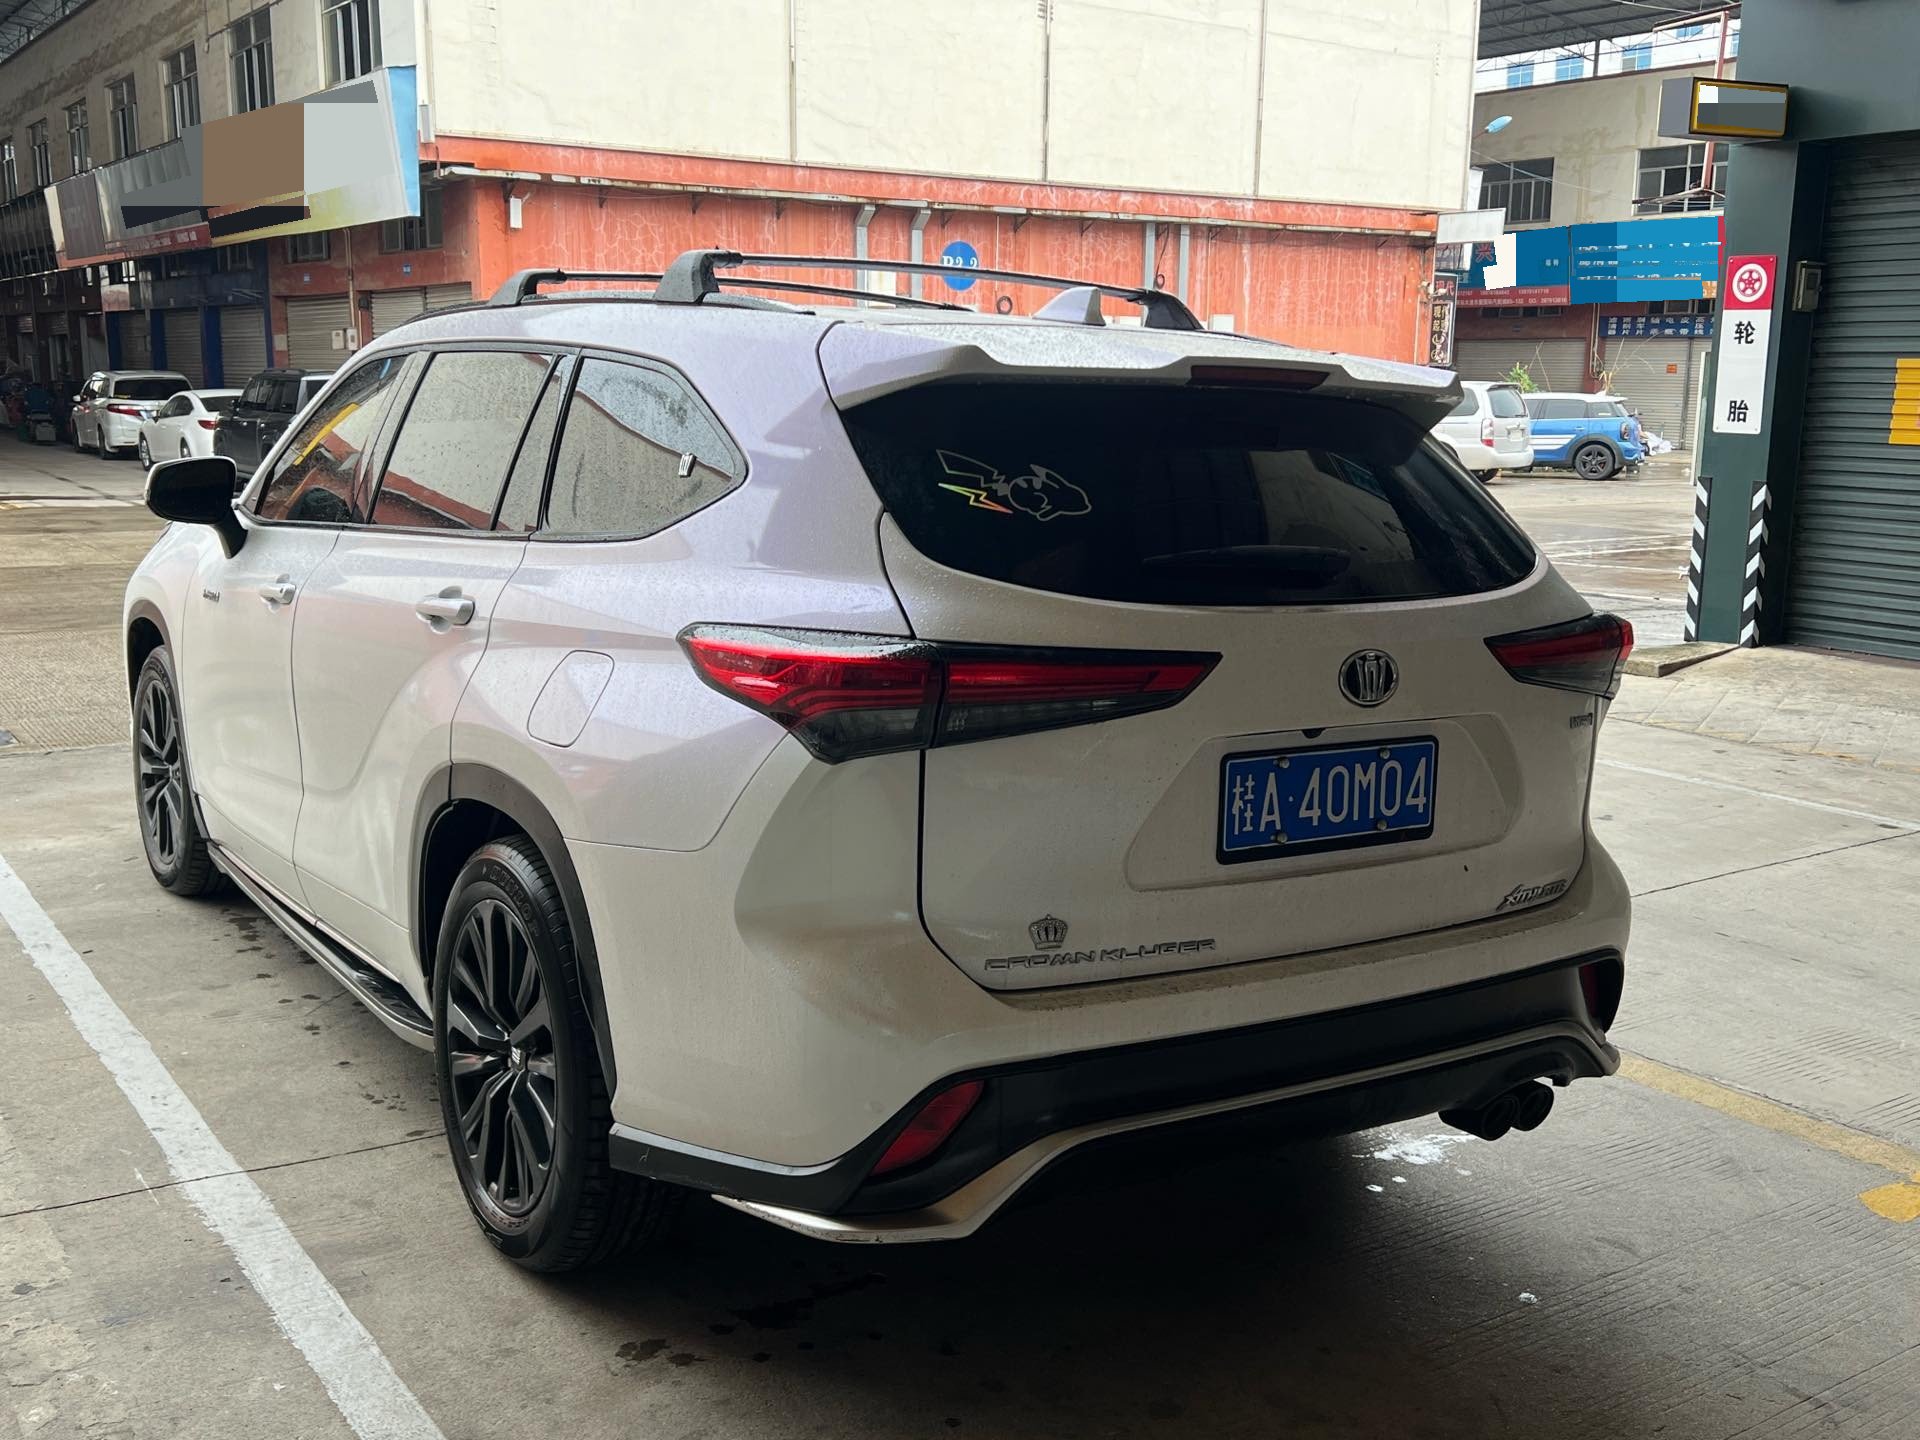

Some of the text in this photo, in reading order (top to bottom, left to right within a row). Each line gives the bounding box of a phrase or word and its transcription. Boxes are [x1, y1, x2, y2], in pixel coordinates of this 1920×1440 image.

[1727, 321, 1755, 423] 轮胎
[984, 938, 1216, 971] CROWN KLUGER
